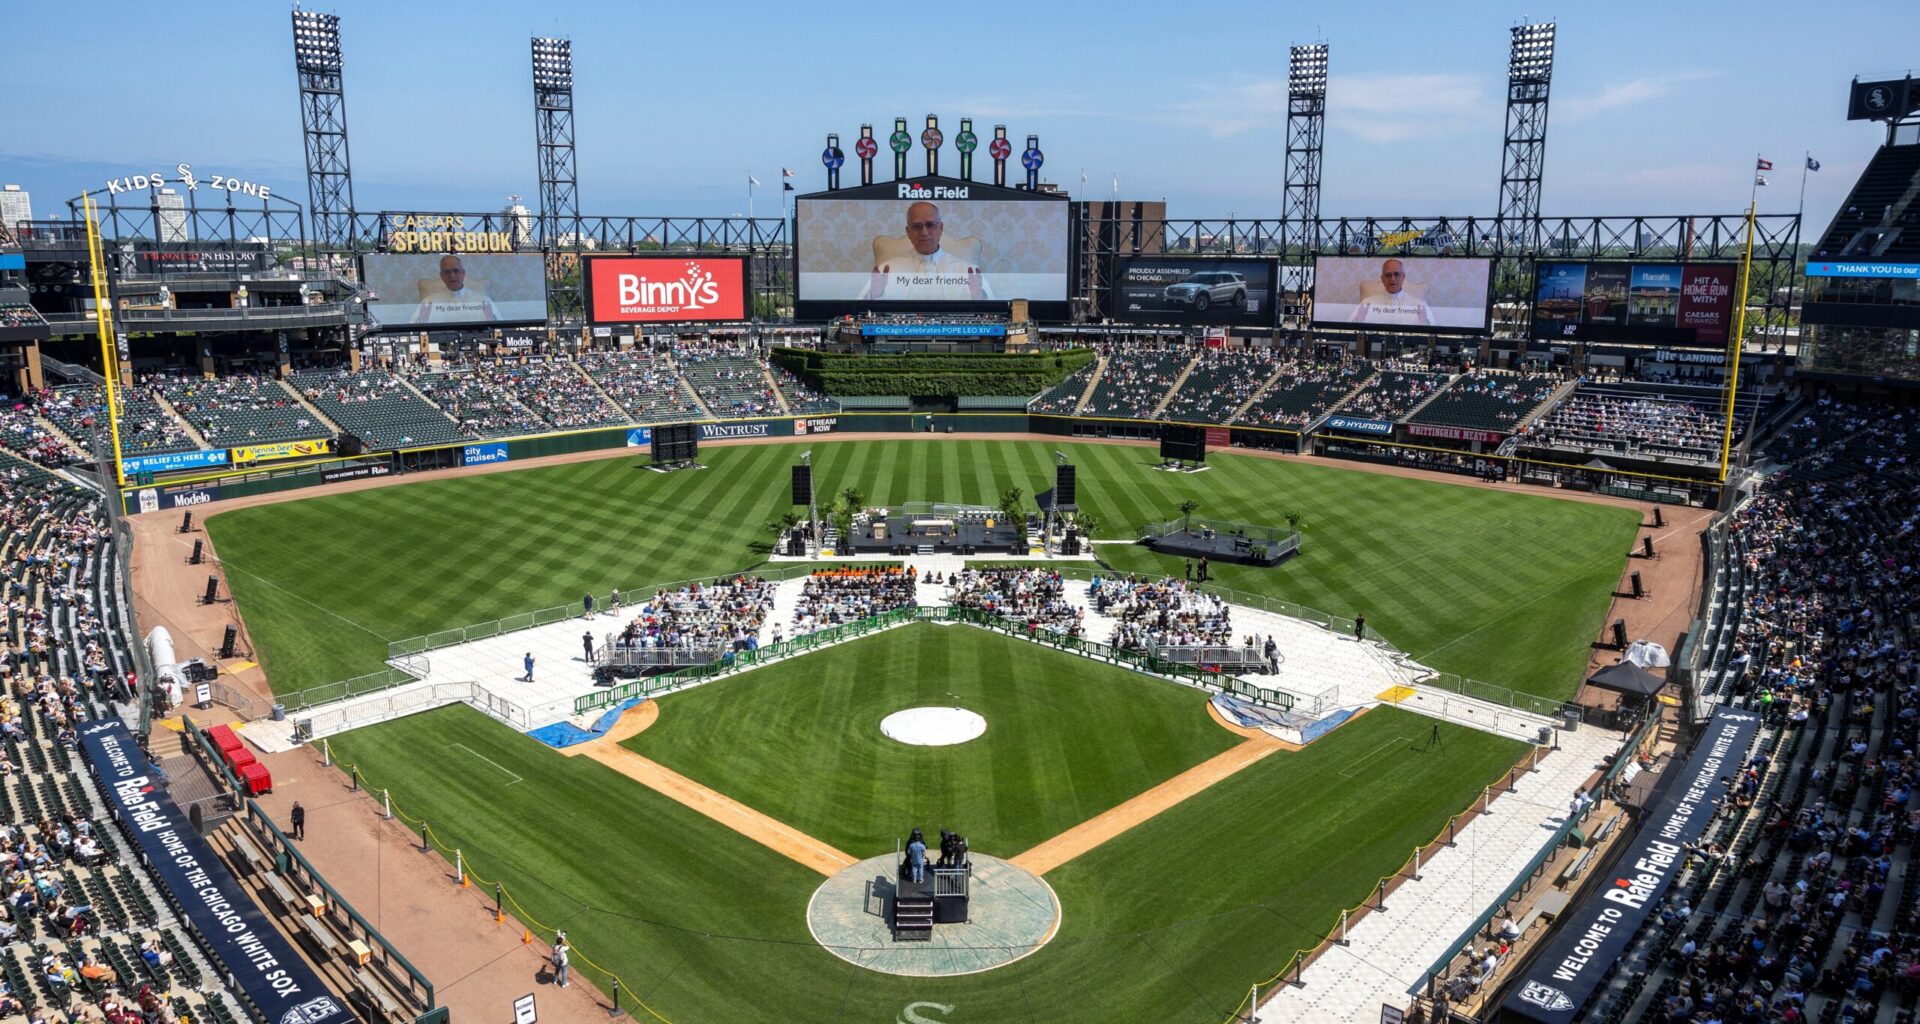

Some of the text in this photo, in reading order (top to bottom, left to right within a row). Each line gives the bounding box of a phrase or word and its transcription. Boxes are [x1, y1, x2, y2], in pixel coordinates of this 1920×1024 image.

[107, 173, 165, 195] KIDS
[211, 175, 271, 200] ZONE
[898, 183, 968, 198] Rate Field
[393, 215, 464, 228] CAESARS
[395, 232, 513, 252] SPORTSBOOK
[1837, 265, 1869, 273] THANK
[1893, 266, 1902, 274] to
[896, 276, 910, 286] My
[912, 276, 933, 285] dear
[1695, 276, 1719, 285] HIT A
[1684, 285, 1728, 295] HOME RUN
[1692, 296, 1717, 304] WITH
[876, 327, 901, 335] Chicago
[506, 337, 533, 346] Modelo
[1679, 354, 1723, 363] LANDING
[808, 418, 836, 426] STREAM
[1347, 421, 1387, 431] HYUNDAI
[1409, 425, 1488, 441] WHITTINGHAM MEATS
[276, 444, 293, 452] Beef
[465, 447, 481, 456] city
[143, 456, 171, 465] RELIEF
[183, 453, 204, 461] HERE
[465, 454, 496, 463] cruises
[372, 466, 389, 474] Rate
[174, 492, 210, 507] Modelo
[1617, 490, 1641, 498] RUSH
[100, 734, 135, 777] WELCOME TO
[1659, 724, 1739, 839] HOME OF THE CHICAGO WHITE SOX
[113, 776, 172, 832] Rate Field
[1604, 840, 1680, 909] Rate Field
[157, 830, 301, 998] HOME OF THE CHICAGO WHITE SOX
[1552, 908, 1623, 981] WELCOME TO
[1519, 980, 1556, 1008] 125
[300, 996, 341, 1021] 125
